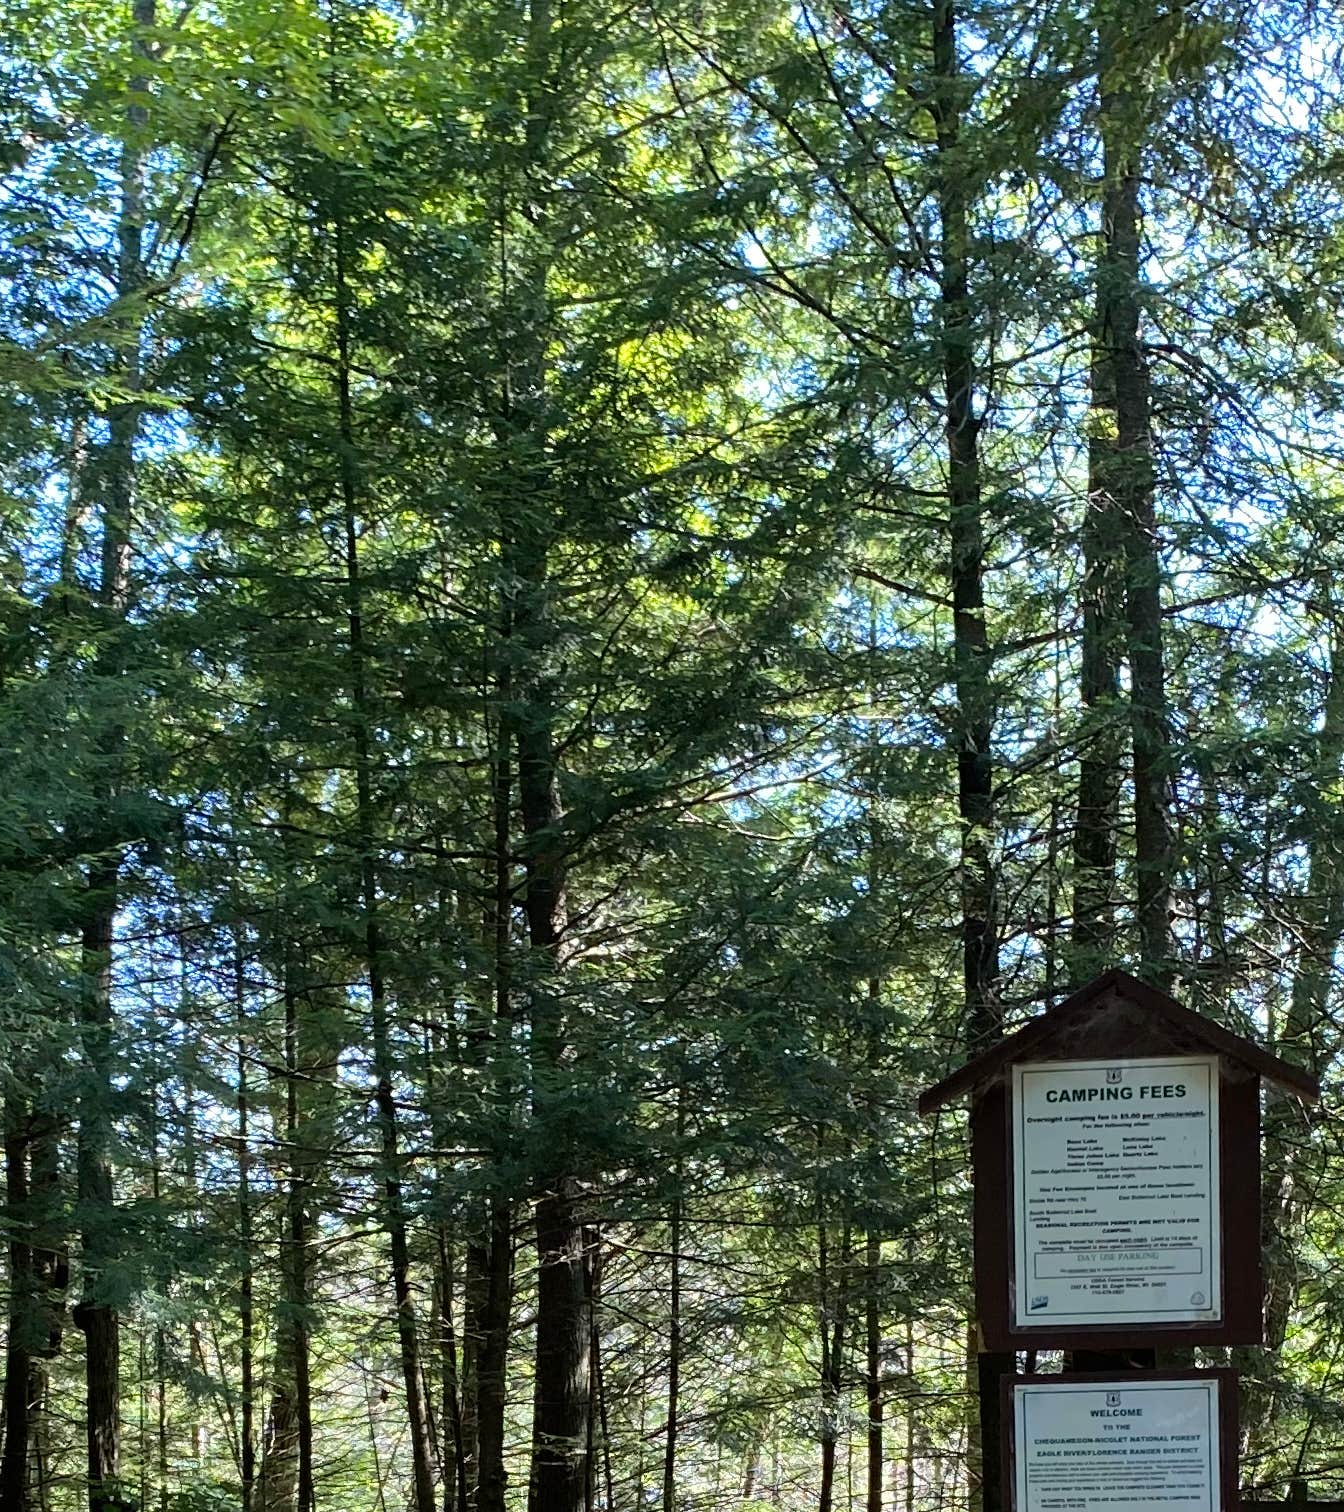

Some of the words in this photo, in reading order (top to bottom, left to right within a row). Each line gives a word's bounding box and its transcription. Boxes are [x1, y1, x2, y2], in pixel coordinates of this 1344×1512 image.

[1046, 1087, 1133, 1103] CAMPING
[1140, 1084, 1186, 1099] FEES
[1077, 1253, 1096, 1262] DAY
[1099, 1252, 1114, 1261] USE
[1118, 1251, 1159, 1261] PARKING
[1090, 1408, 1143, 1417] WELCOME
